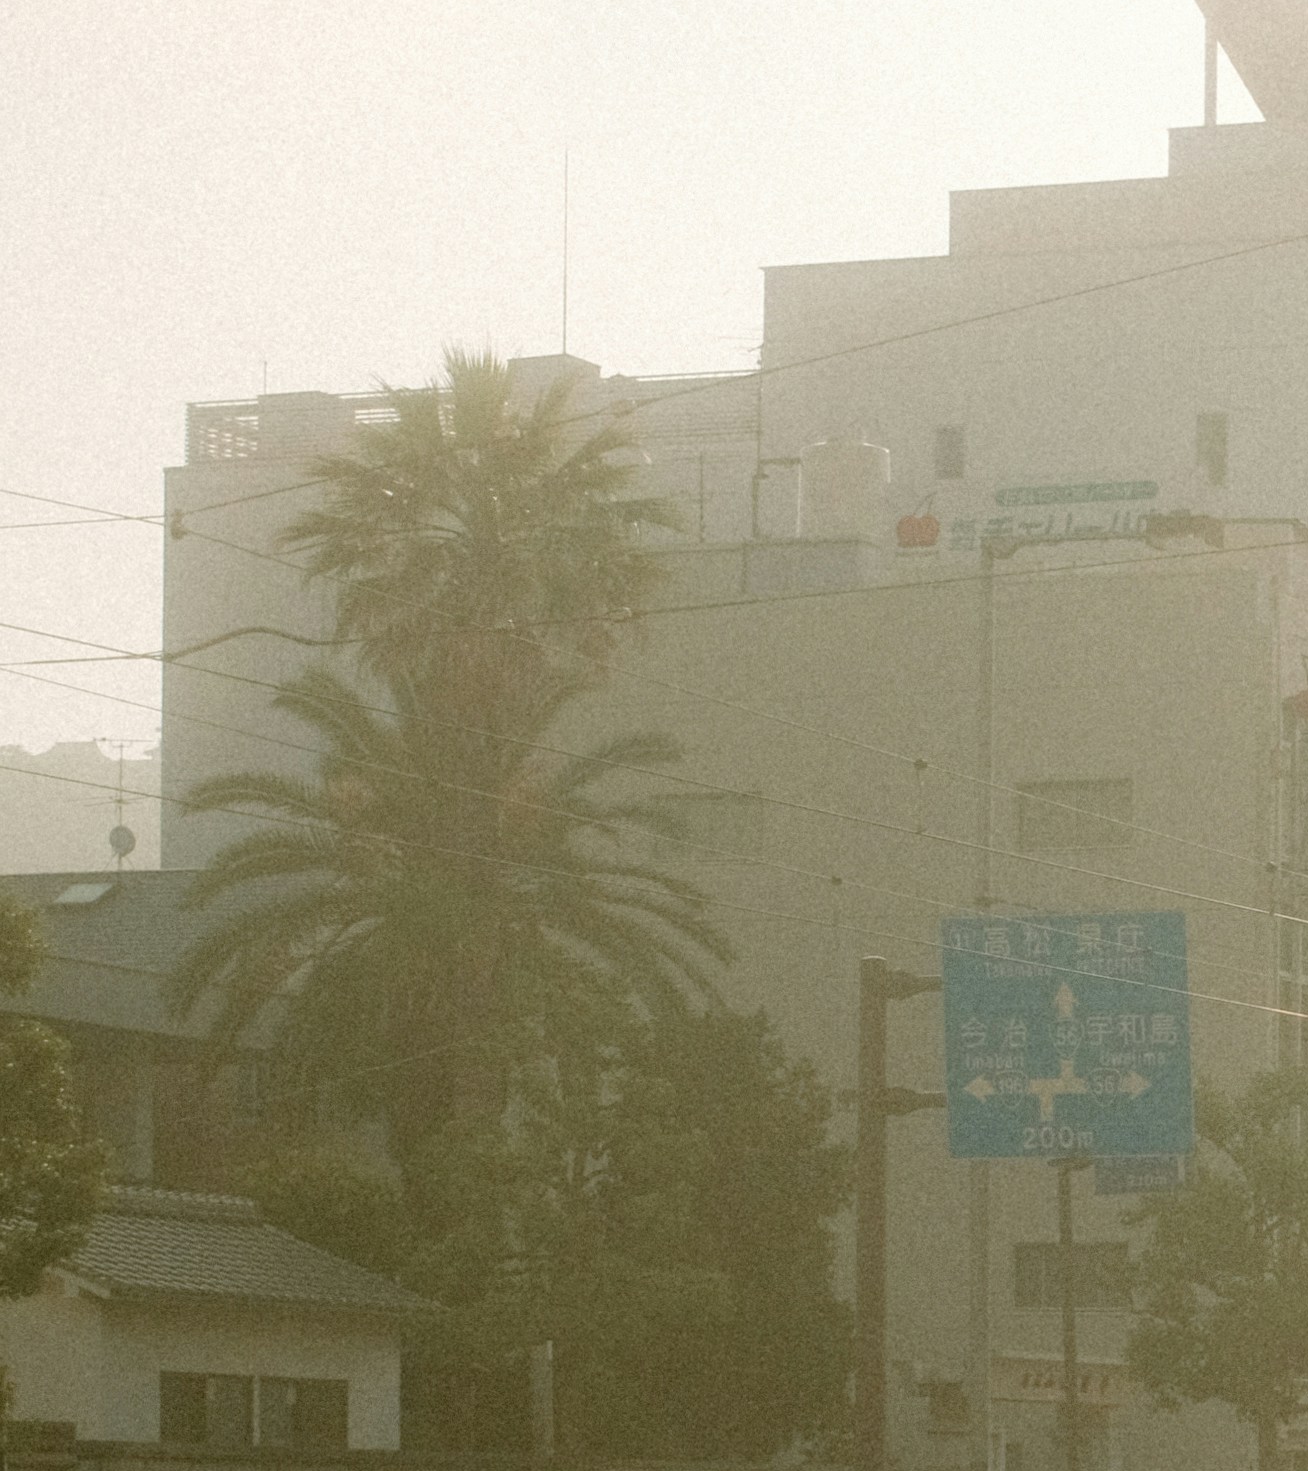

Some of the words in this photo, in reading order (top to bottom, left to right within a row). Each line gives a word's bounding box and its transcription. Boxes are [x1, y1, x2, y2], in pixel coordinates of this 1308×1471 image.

[983, 924, 1052, 957] 高松
[960, 1016, 1028, 1050] 今治
[1055, 1025, 1080, 1045] 56
[1086, 1013, 1179, 1045] 宇和島
[998, 1078, 1024, 1096] 196
[1093, 1075, 1116, 1095] 56
[1023, 1126, 1095, 1149] 200m
